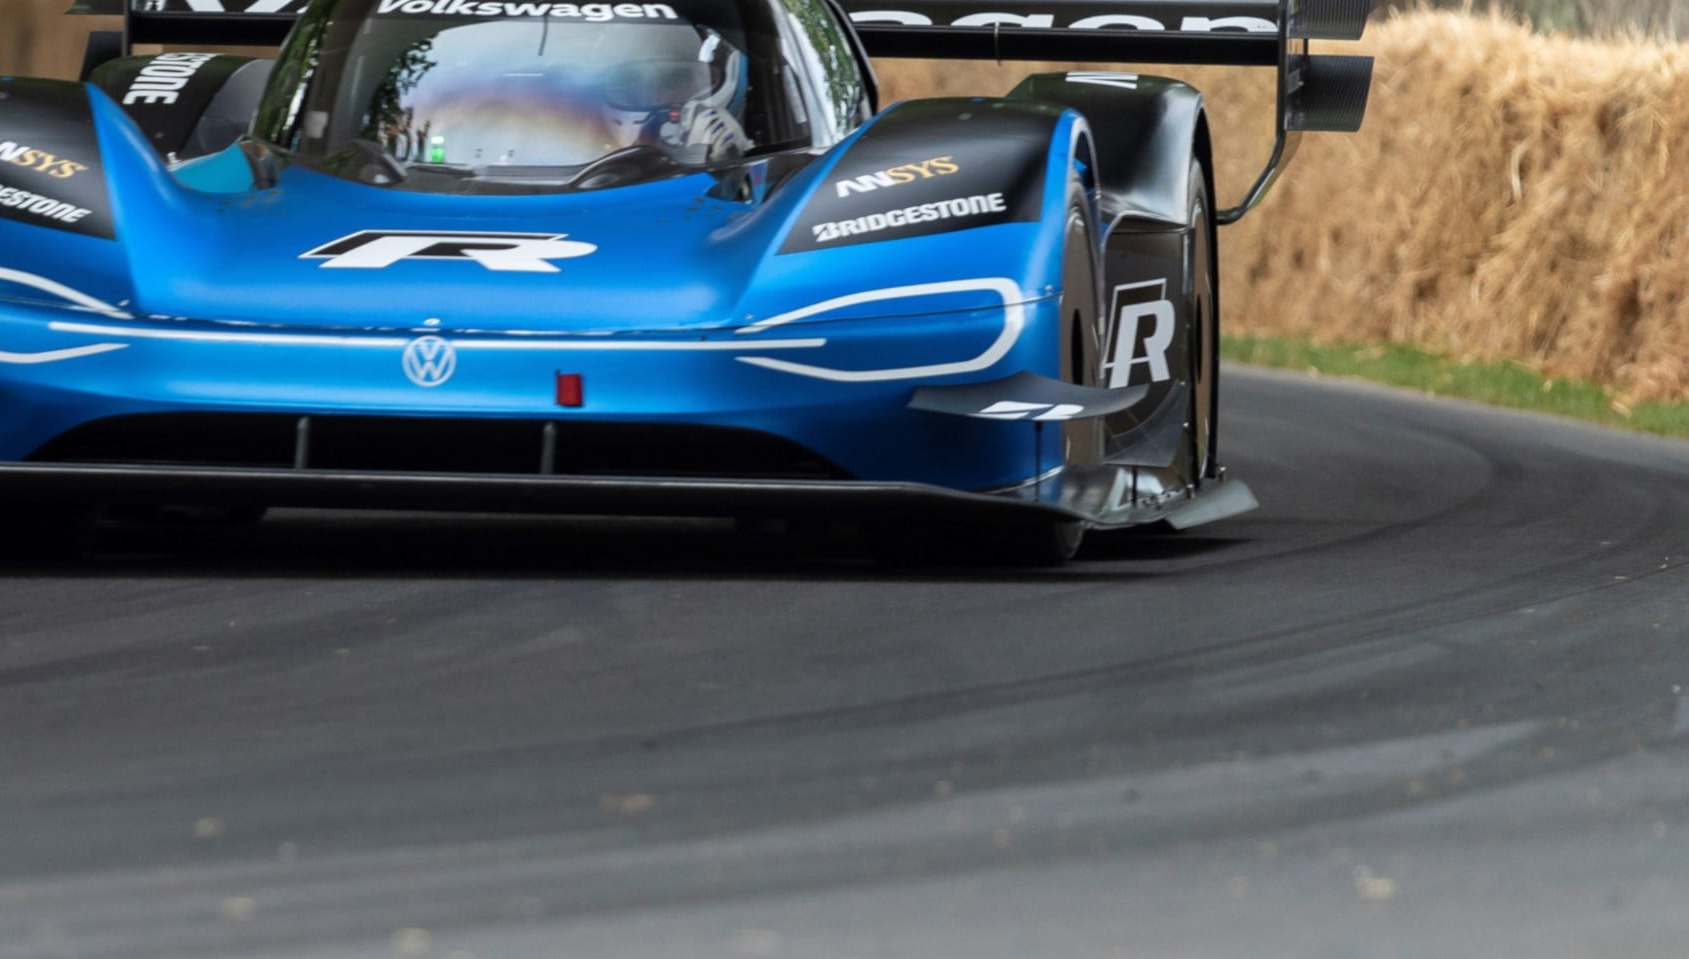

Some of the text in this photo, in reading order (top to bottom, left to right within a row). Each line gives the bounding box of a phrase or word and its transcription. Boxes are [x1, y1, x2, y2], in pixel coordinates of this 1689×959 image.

[835, 155, 959, 198] ANSYS
[812, 192, 1007, 242] BRIDGESTONE
[300, 230, 599, 272] R
[1109, 297, 1176, 389] R
